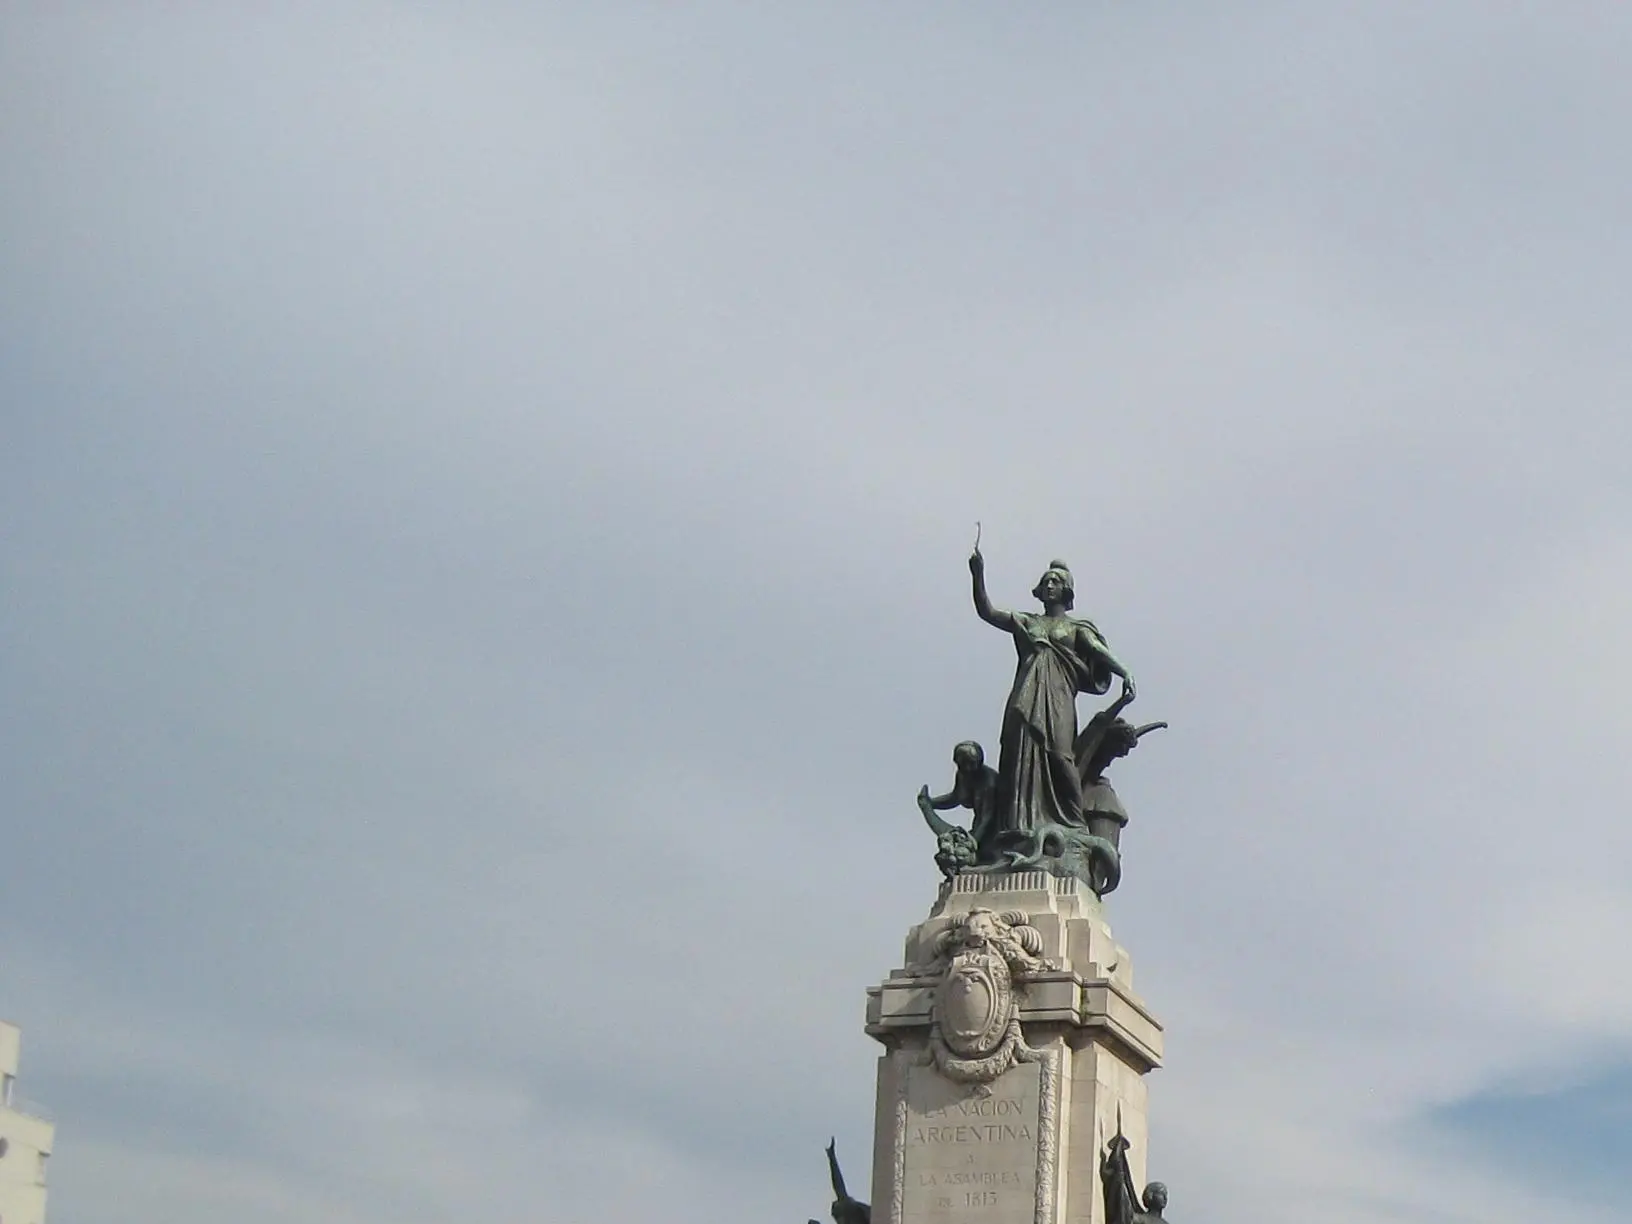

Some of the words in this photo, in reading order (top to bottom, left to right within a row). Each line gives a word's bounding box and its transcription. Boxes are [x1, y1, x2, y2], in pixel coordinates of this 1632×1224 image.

[924, 1102, 947, 1118] LA
[957, 1099, 1024, 1117] NACION
[914, 1124, 1031, 1143] ARGENTINA
[919, 1174, 937, 1187] LA
[944, 1171, 1020, 1185] ASAMBLEA
